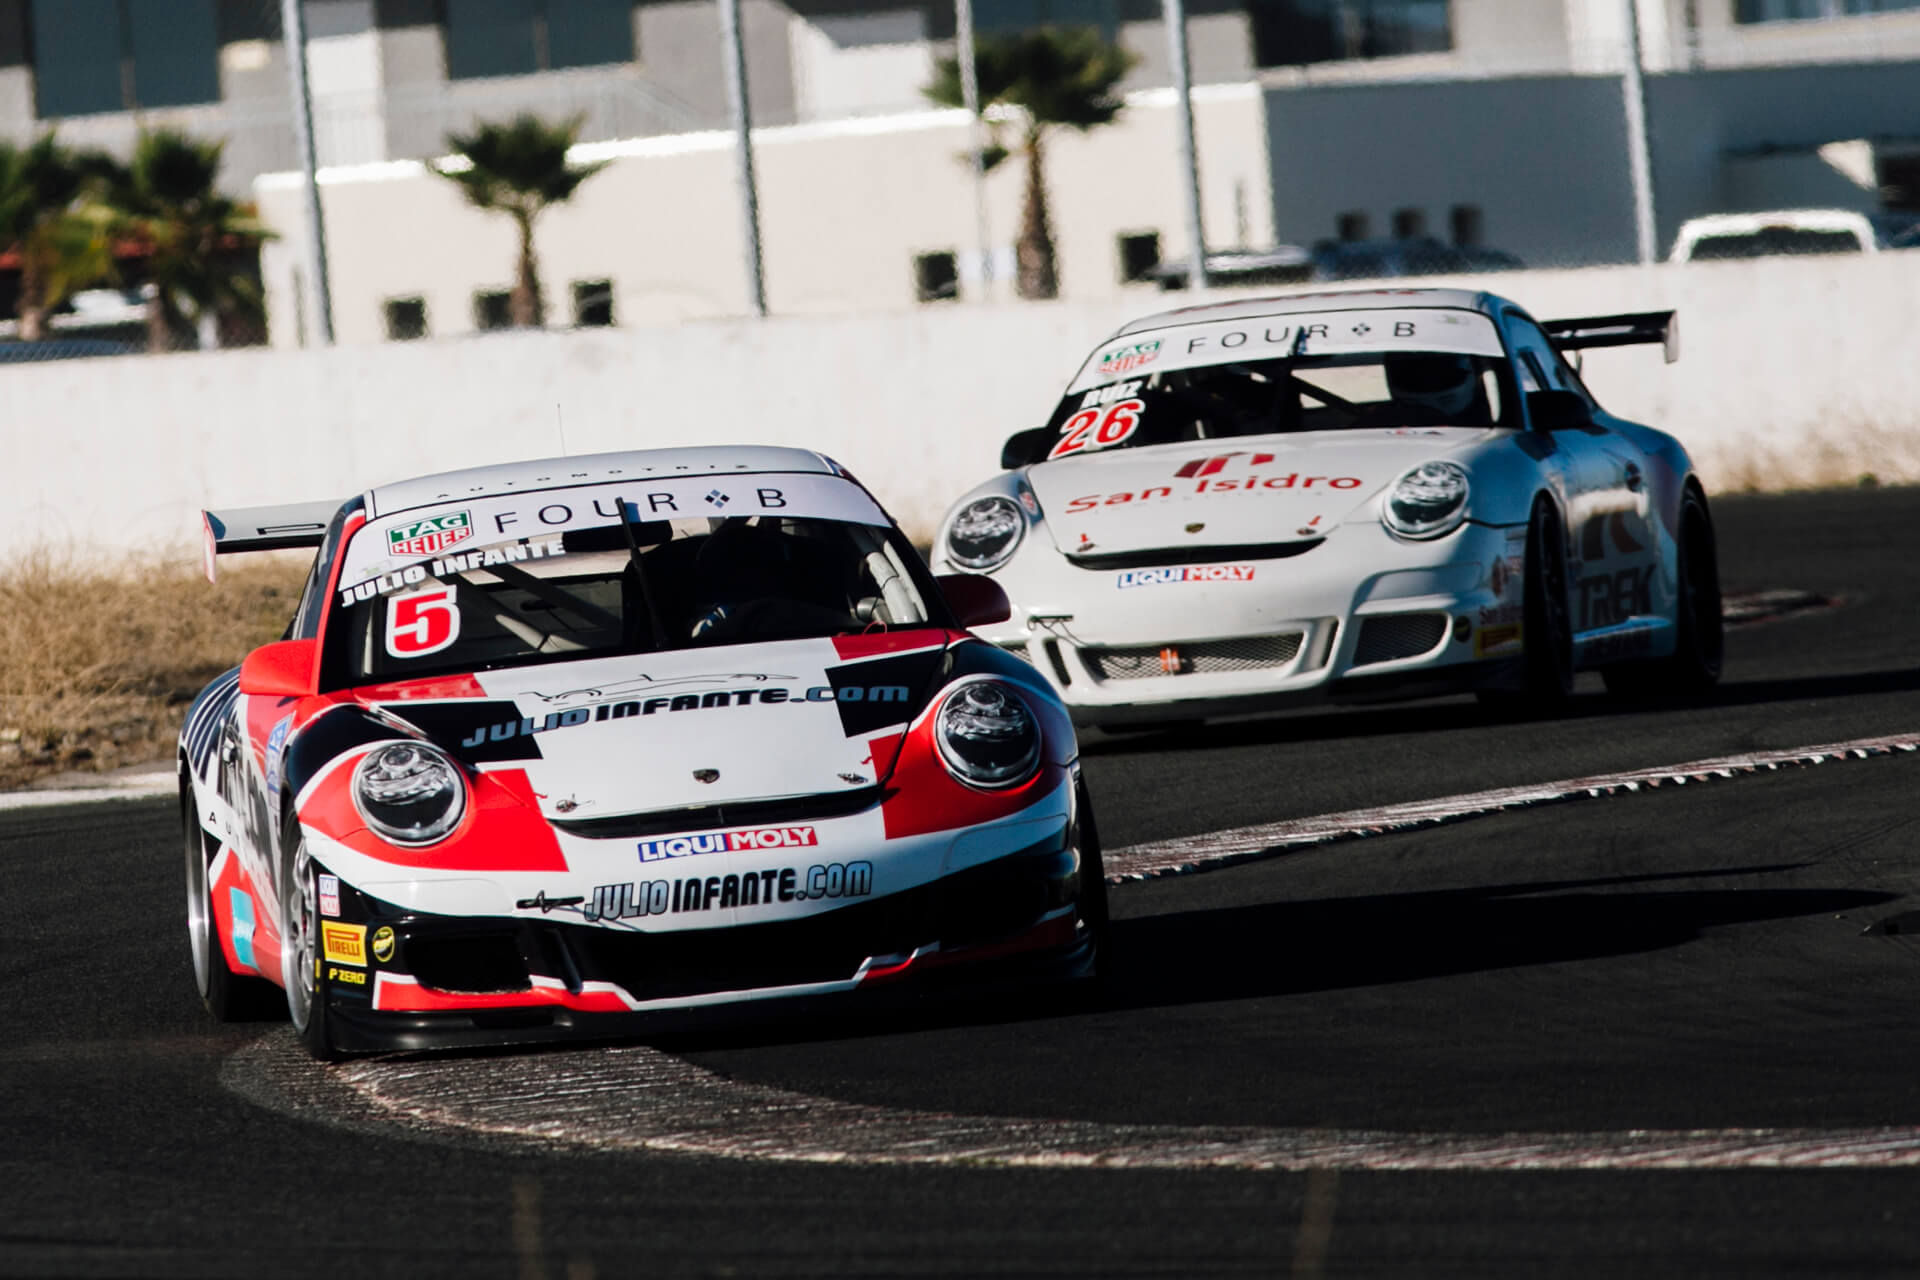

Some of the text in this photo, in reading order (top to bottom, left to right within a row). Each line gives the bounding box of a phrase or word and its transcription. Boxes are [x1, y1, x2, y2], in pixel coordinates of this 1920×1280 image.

[1187, 321, 1416, 354] FOUR B
[1047, 399, 1146, 459] 26
[1065, 486, 1172, 514] San
[1195, 473, 1363, 494] Isidro
[394, 515, 465, 539] TAG
[493, 488, 787, 534] FOUR B
[393, 527, 471, 554] HEUER
[341, 539, 567, 608] JULIO INFANTE
[1119, 566, 1254, 589] LIQUI MOLY
[387, 587, 459, 656] 5
[639, 827, 816, 861] LIQUI MOLY
[326, 928, 361, 956] PIRELLI
[328, 967, 367, 985] P ZERO
